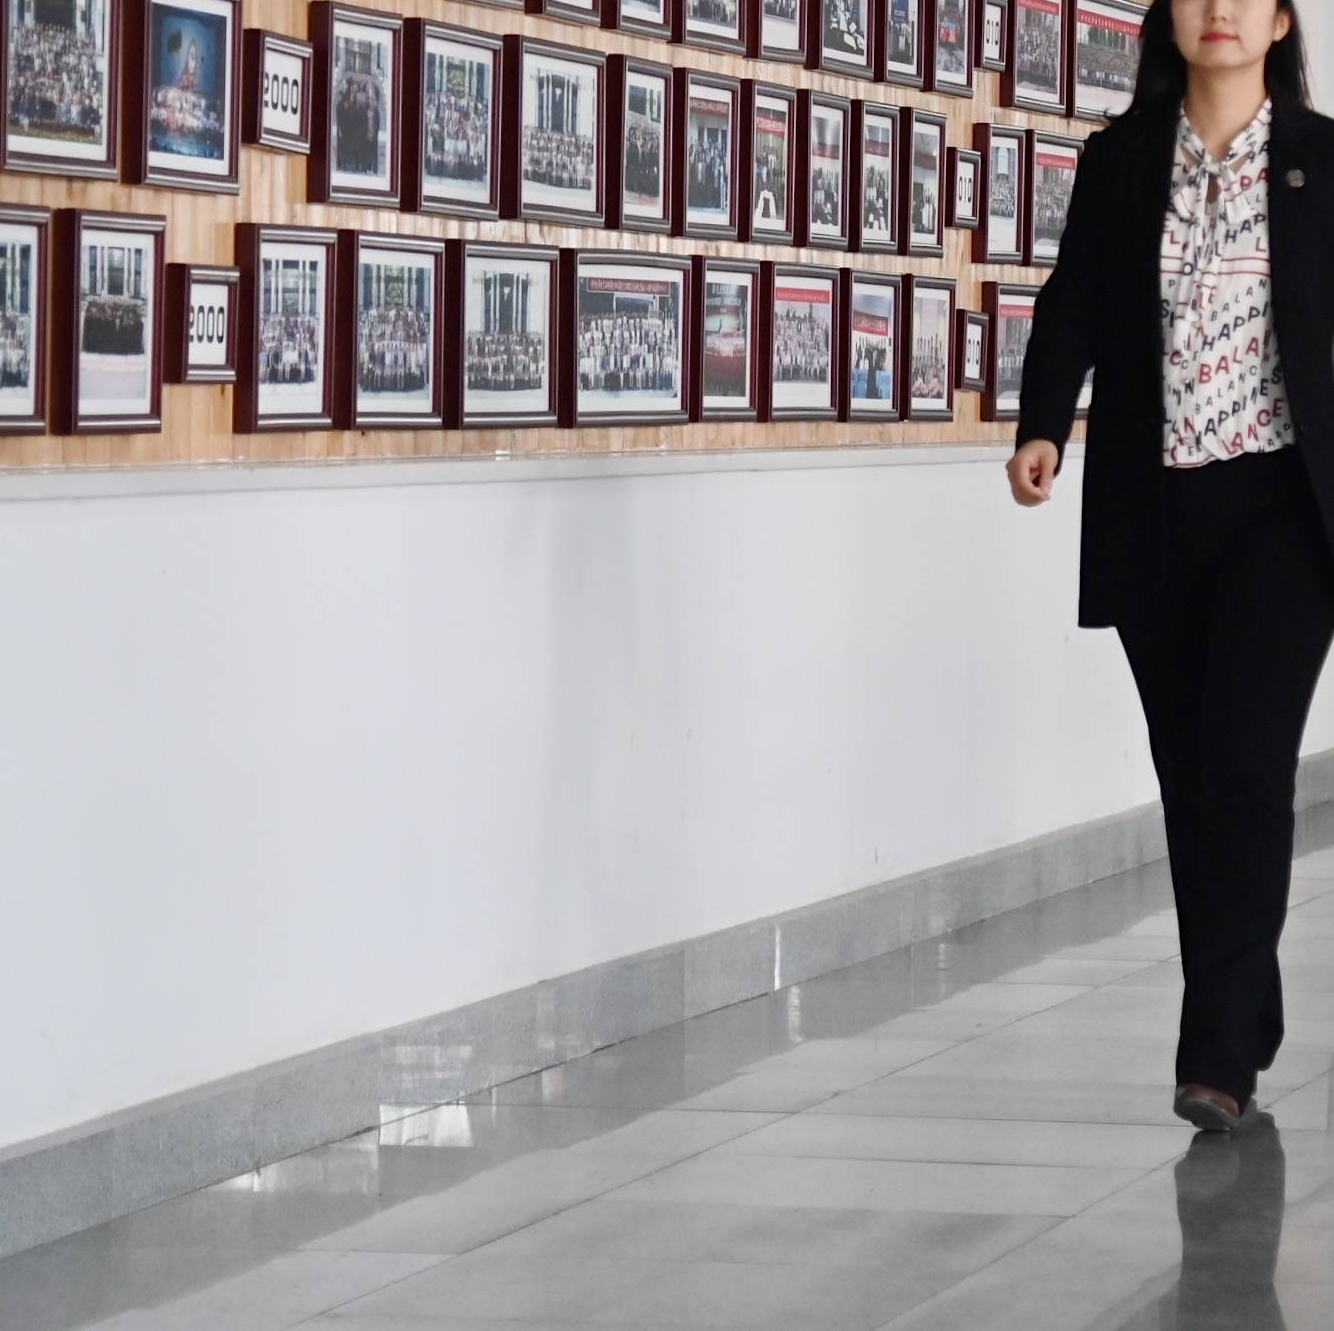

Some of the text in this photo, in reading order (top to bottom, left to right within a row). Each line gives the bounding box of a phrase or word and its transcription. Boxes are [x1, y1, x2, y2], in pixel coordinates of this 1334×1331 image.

[986, 19, 999, 46] 010
[959, 176, 972, 203] 010
[967, 338, 980, 365] 010
